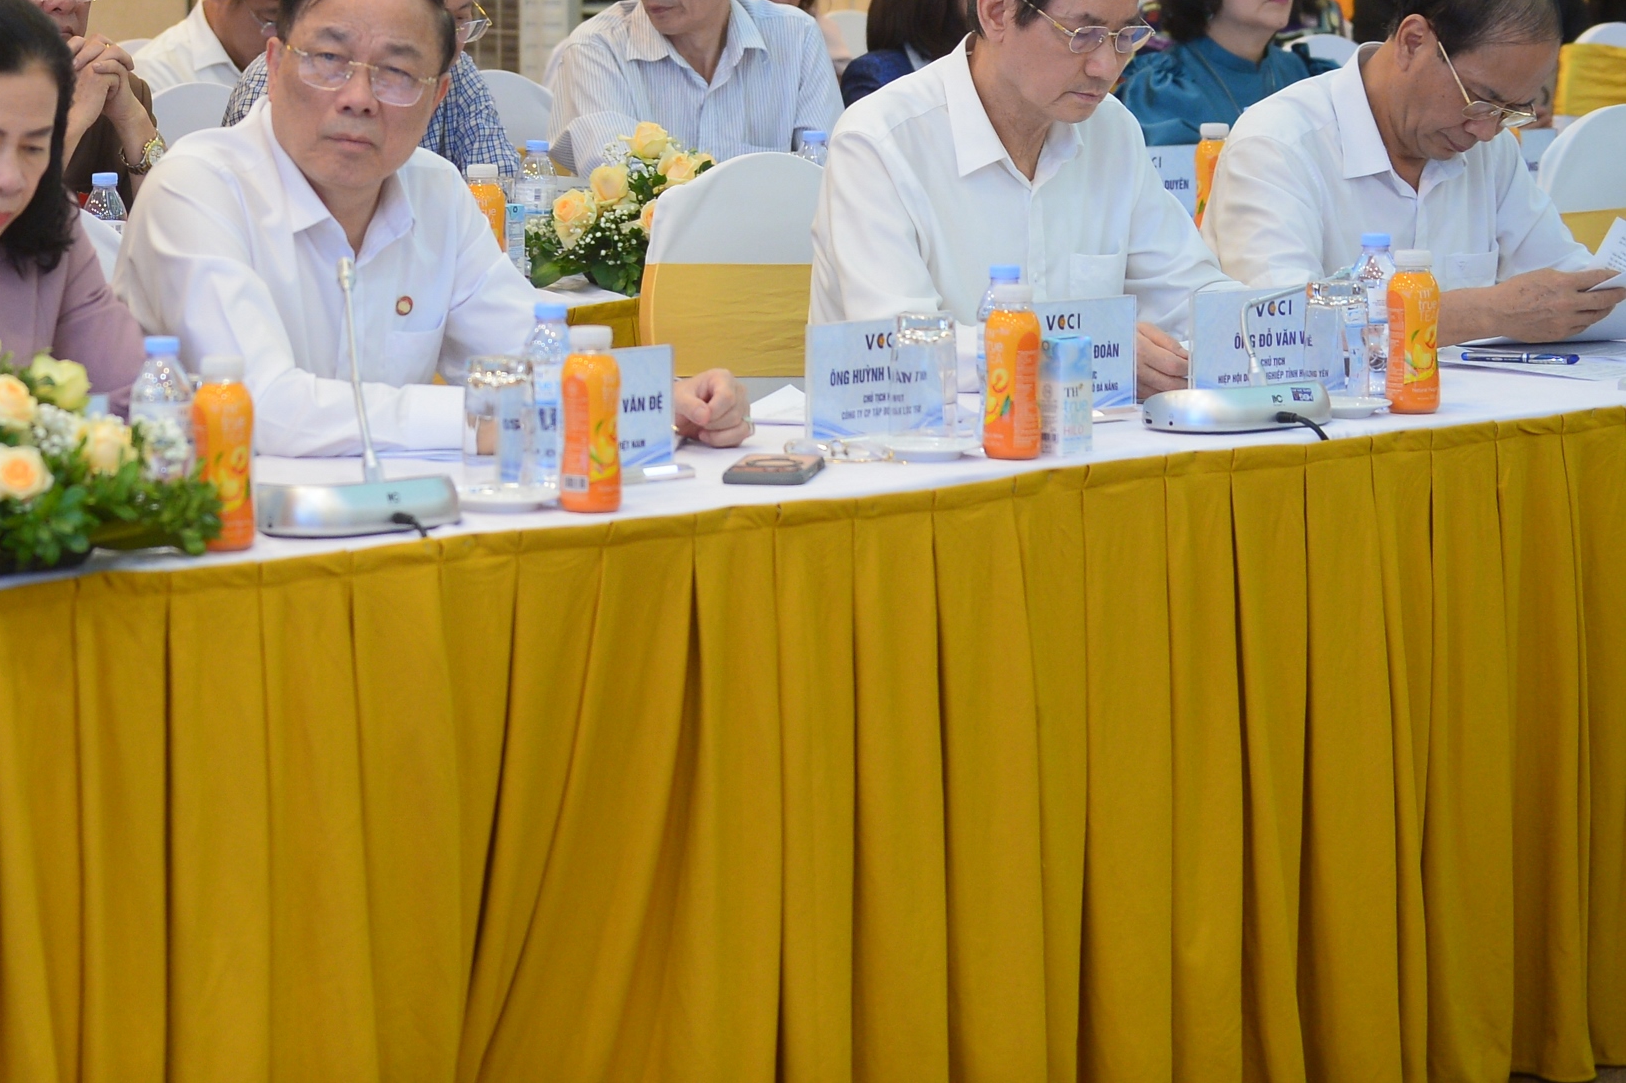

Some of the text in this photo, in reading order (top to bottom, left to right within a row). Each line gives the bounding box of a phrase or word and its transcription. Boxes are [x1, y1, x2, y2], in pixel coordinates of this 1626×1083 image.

[1046, 313, 1081, 331] VCCI
[865, 332, 893, 350] VCC
[1276, 328, 1297, 347] VĂN
[1093, 341, 1120, 359] ĐOÀN
[830, 368, 850, 386] ÔNG
[852, 364, 885, 384] HUỲNH
[649, 390, 664, 414] ĐỆ
